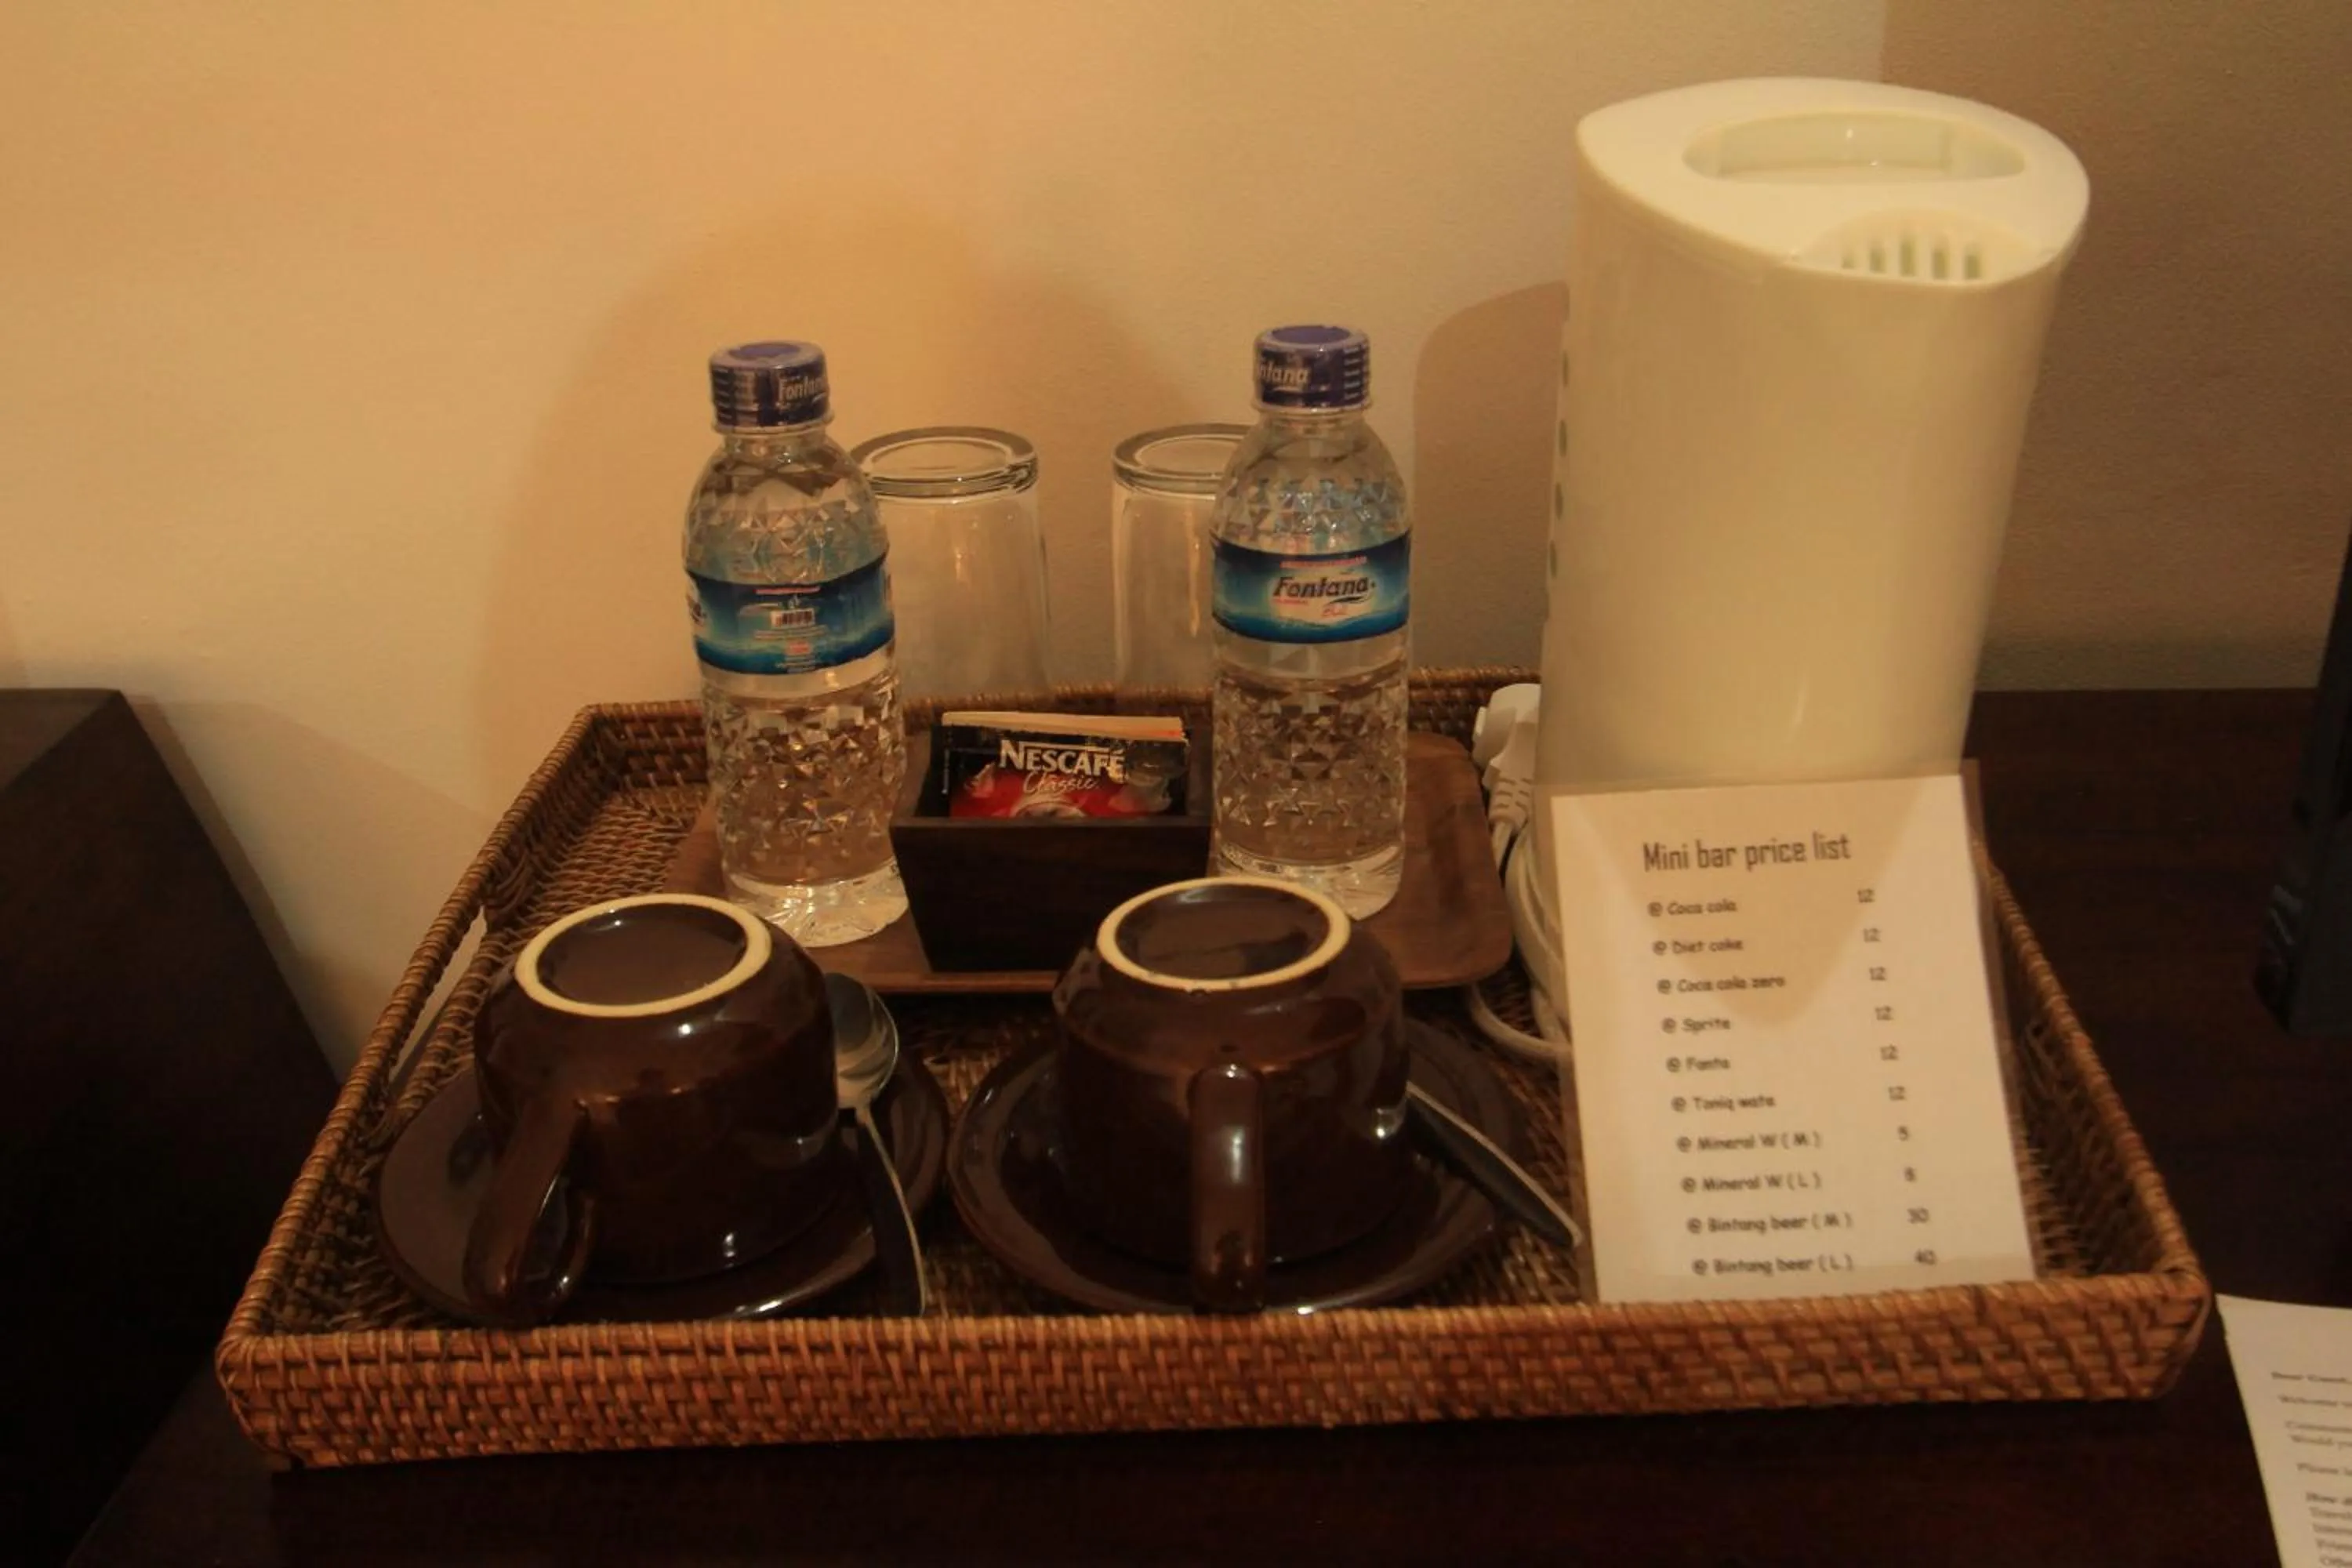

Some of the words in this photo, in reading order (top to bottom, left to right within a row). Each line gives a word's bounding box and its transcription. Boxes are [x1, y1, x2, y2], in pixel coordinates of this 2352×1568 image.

[1259, 357, 1308, 384] ntana
[1272, 576, 1369, 598] Fontana
[999, 739, 1127, 785] NESCAFÉ
[1023, 770, 1098, 794] Classic
[1642, 841, 1690, 873] Mini
[1694, 839, 1738, 869] bar
[1744, 837, 1808, 873] price
[1812, 831, 1852, 861] list
[1666, 901, 1704, 916] Coca
[1857, 887, 1875, 904] 12
[1863, 927, 1881, 942] 12
[1676, 978, 1715, 993] Coca
[1868, 966, 1887, 982] 12
[1682, 1017, 1731, 1035] Sprite
[1875, 1005, 1894, 1022] 12
[1880, 1044, 1899, 1062] 12
[1888, 1085, 1906, 1102] 12
[1697, 1134, 1757, 1152] Mineral
[1701, 1175, 1762, 1192] Mineral
[1707, 1217, 1769, 1236] Bintang
[1769, 1215, 1809, 1231] beer
[1712, 1258, 1773, 1277] Bintang
[1775, 1258, 1814, 1272] beer
